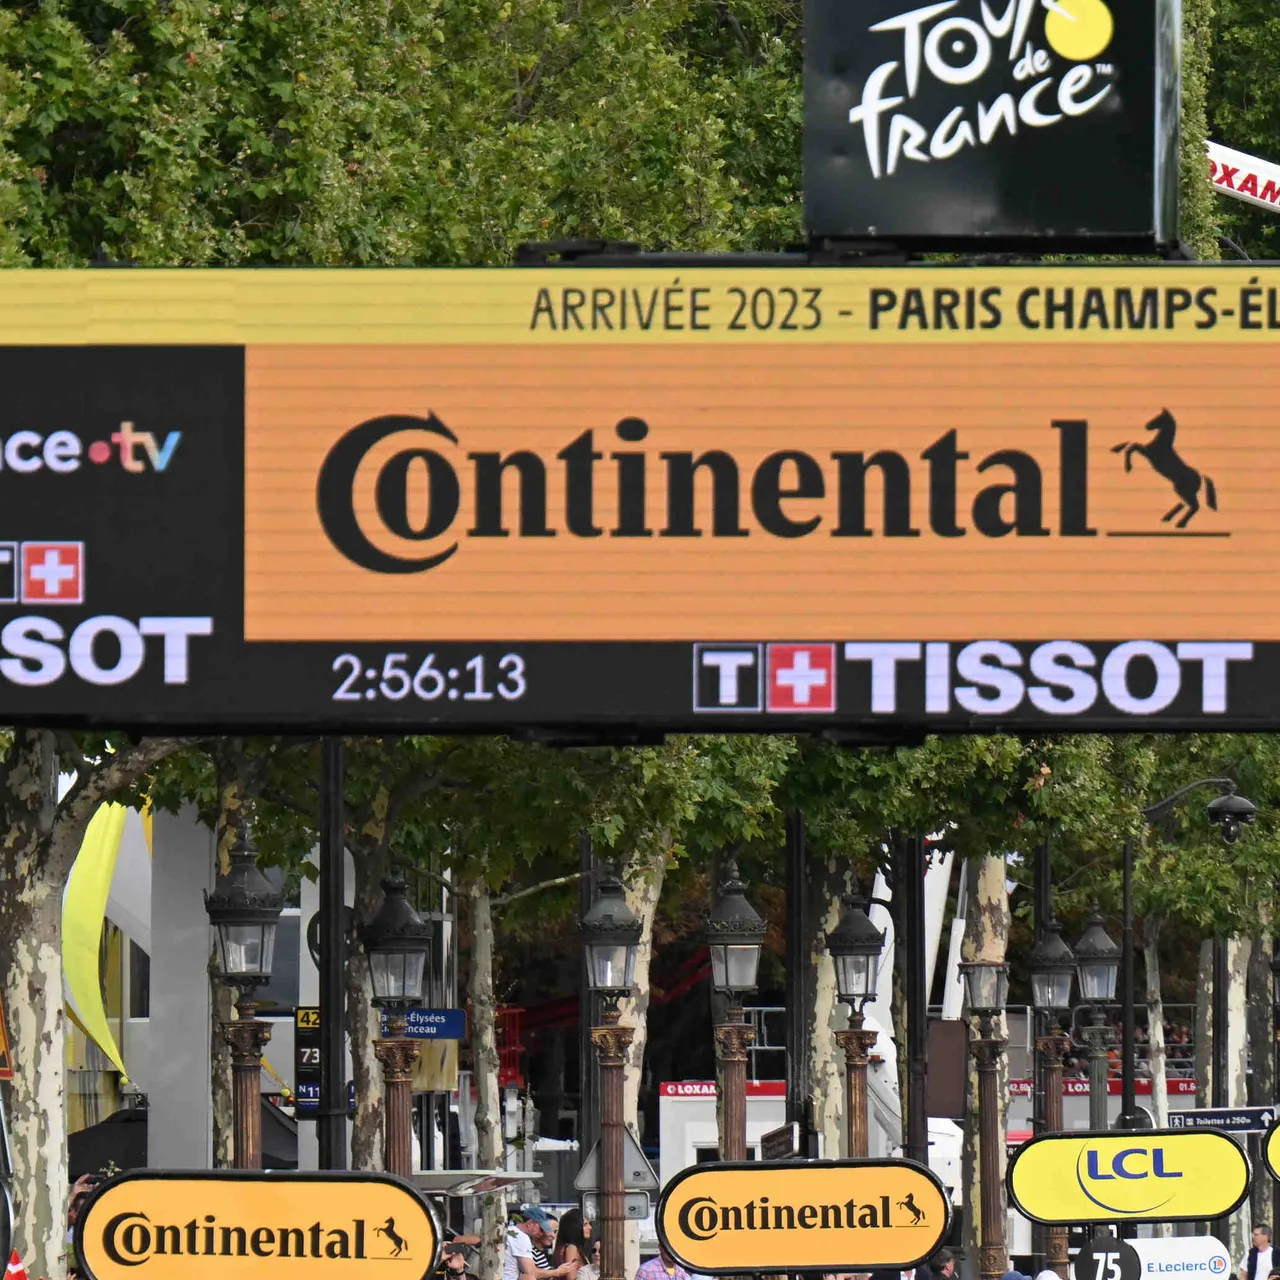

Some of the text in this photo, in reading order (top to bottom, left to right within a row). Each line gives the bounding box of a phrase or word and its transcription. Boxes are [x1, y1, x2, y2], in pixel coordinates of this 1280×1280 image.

[1015, 51, 1051, 81] de
[850, 64, 1112, 180] france
[530, 277, 712, 331] ARRIVÉE
[726, 287, 823, 331] 2023
[868, 287, 1002, 330] PARIS
[316, 408, 1098, 575] Continental
[332, 652, 527, 701] 2:56:13
[845, 640, 1254, 716] TISSOT
[1195, 1117, 1224, 1126] Toilettes
[1087, 1147, 1184, 1180] LCL
[102, 1210, 368, 1266] Continental
[678, 1196, 893, 1241] Continental
[1147, 1258, 1207, 1274] E.Leclerc
